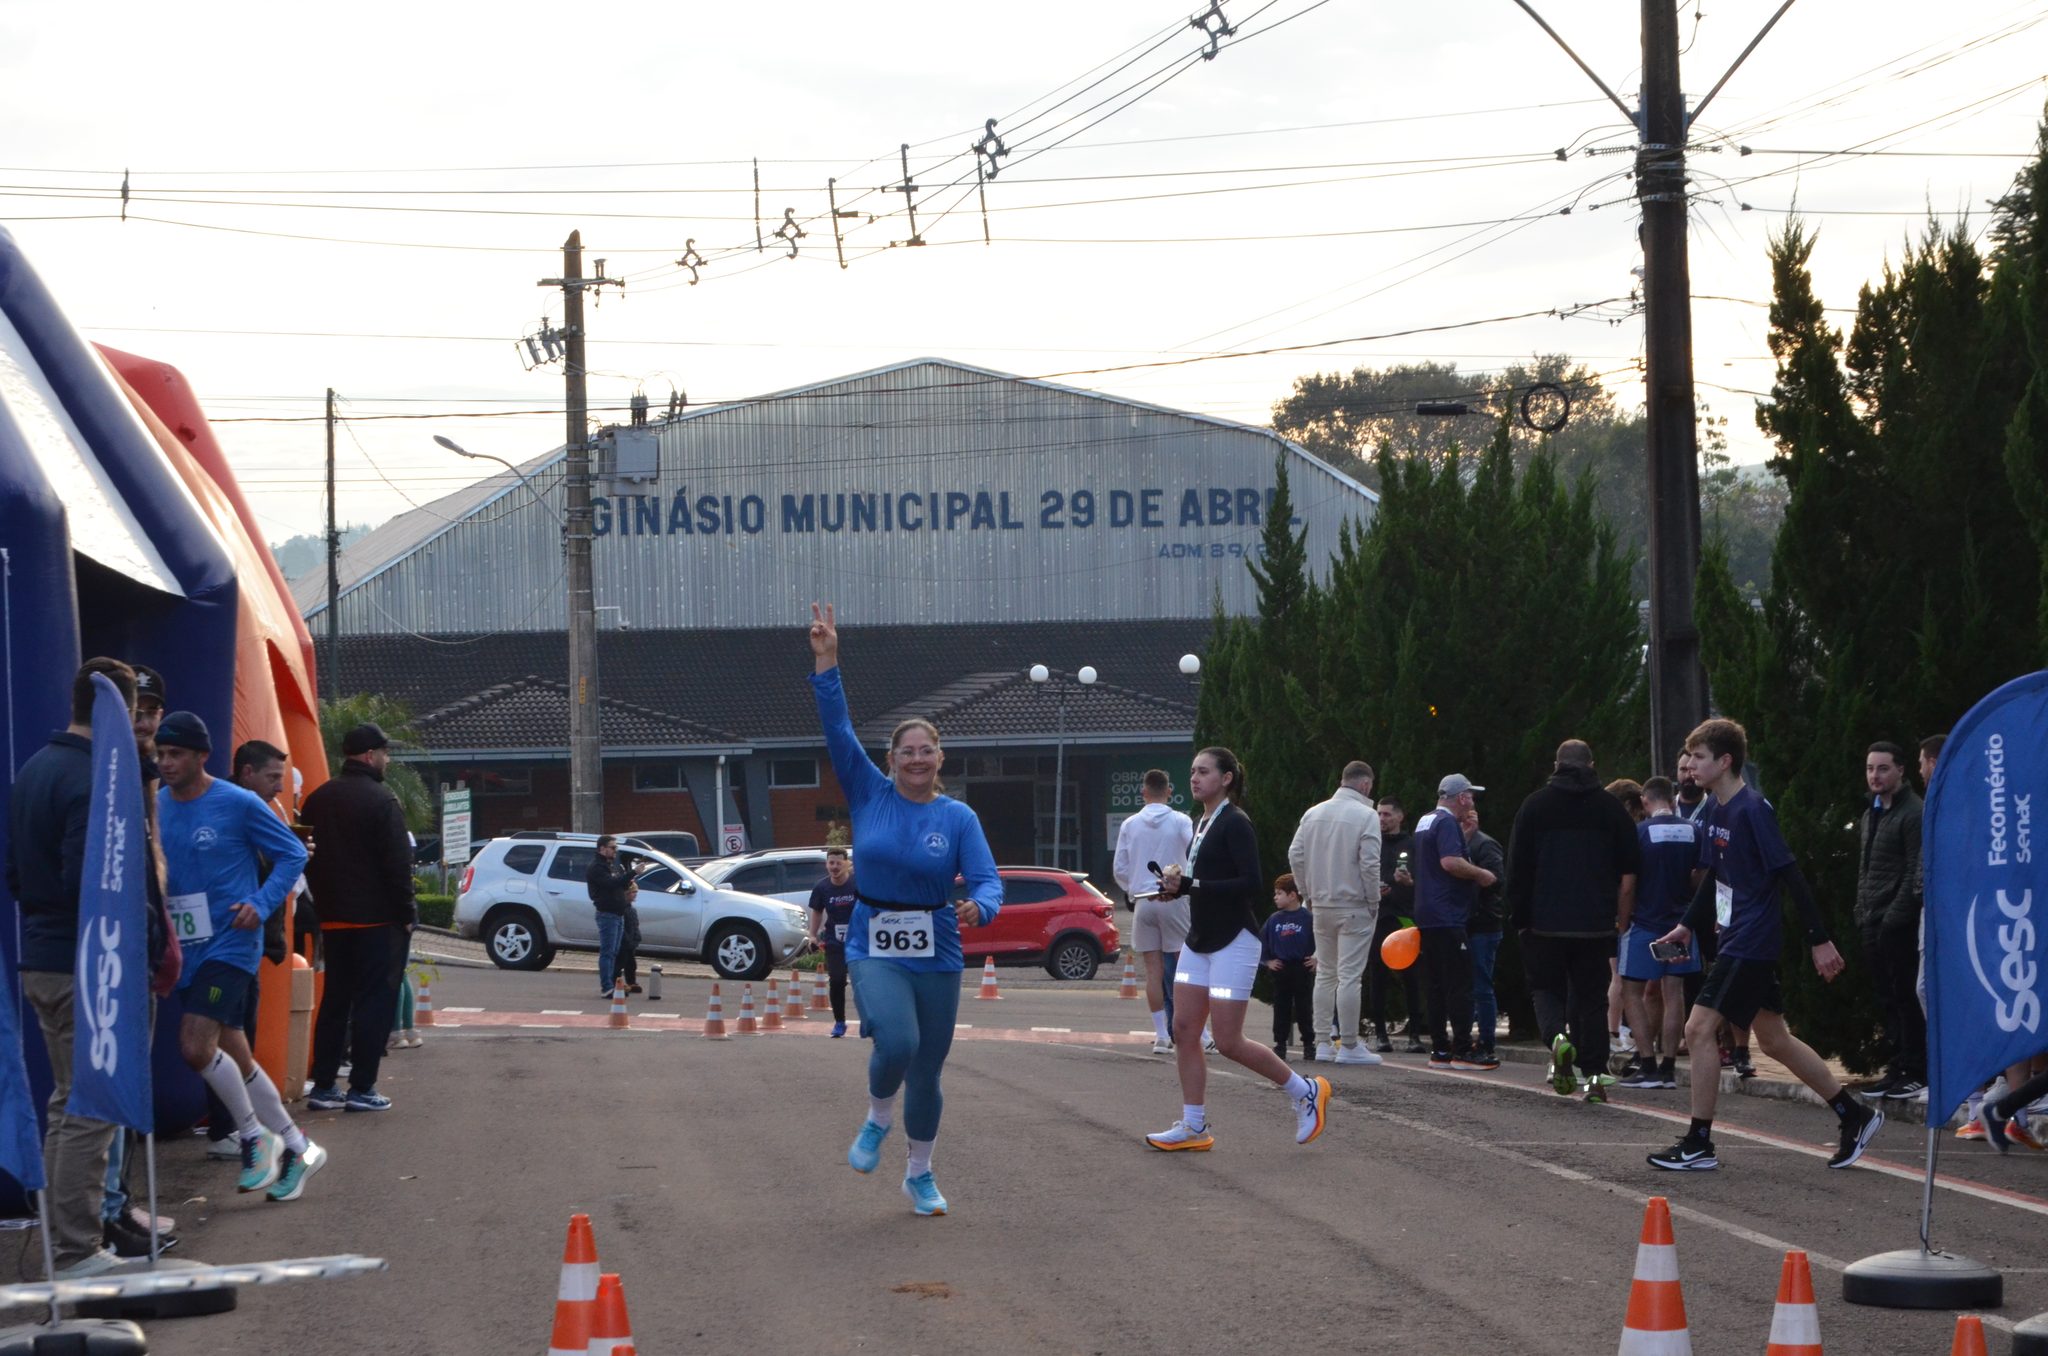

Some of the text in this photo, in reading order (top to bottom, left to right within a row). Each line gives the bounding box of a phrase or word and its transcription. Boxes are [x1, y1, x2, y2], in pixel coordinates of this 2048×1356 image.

[591, 485, 765, 536] GINÁSIO
[781, 491, 1024, 533] MUNICIPAL
[1040, 489, 1095, 529] 29
[1109, 488, 1164, 528] DE
[1158, 543, 1201, 558] ADM
[1112, 795, 1131, 806] DO
[1984, 733, 2008, 866] Fecomércio
[875, 929, 929, 950] 963
